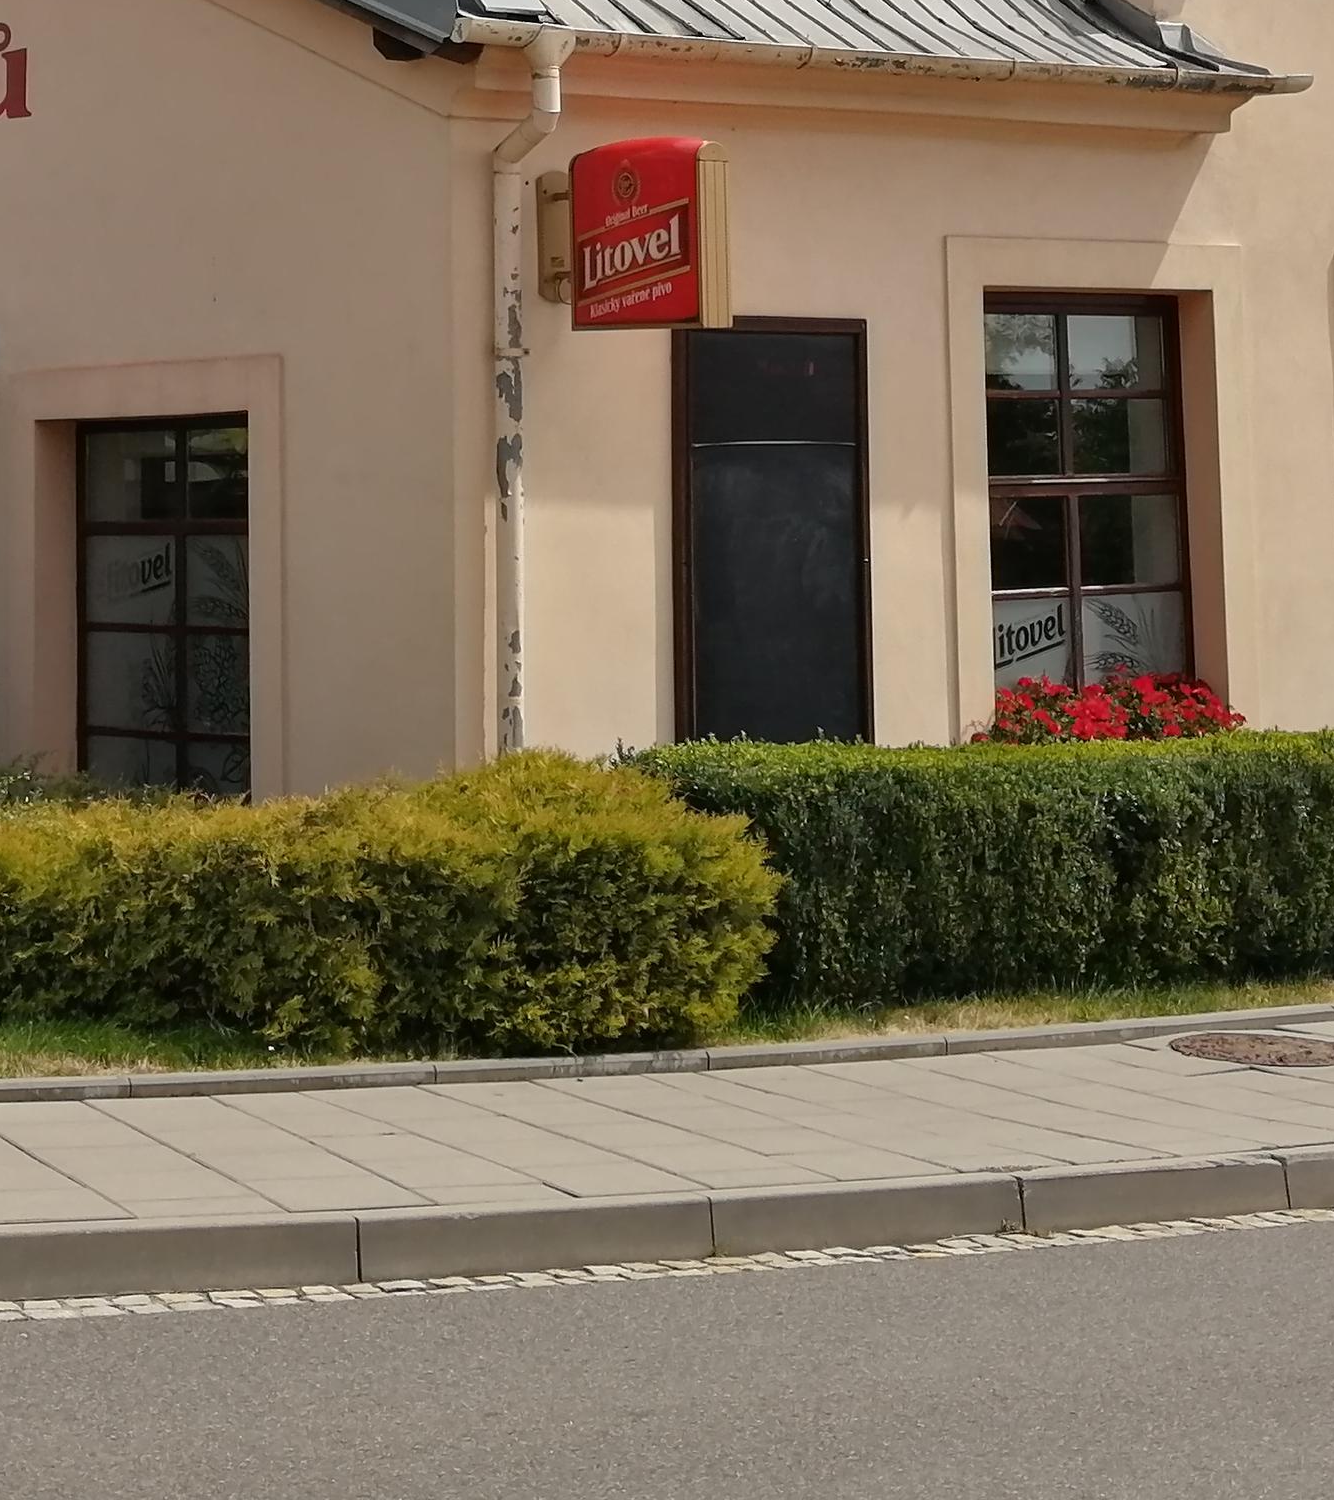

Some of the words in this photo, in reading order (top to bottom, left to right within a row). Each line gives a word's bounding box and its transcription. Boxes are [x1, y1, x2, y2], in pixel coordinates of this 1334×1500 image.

[632, 203, 649, 218] Beer
[583, 213, 682, 292] Litovel
[652, 281, 673, 301] pivo
